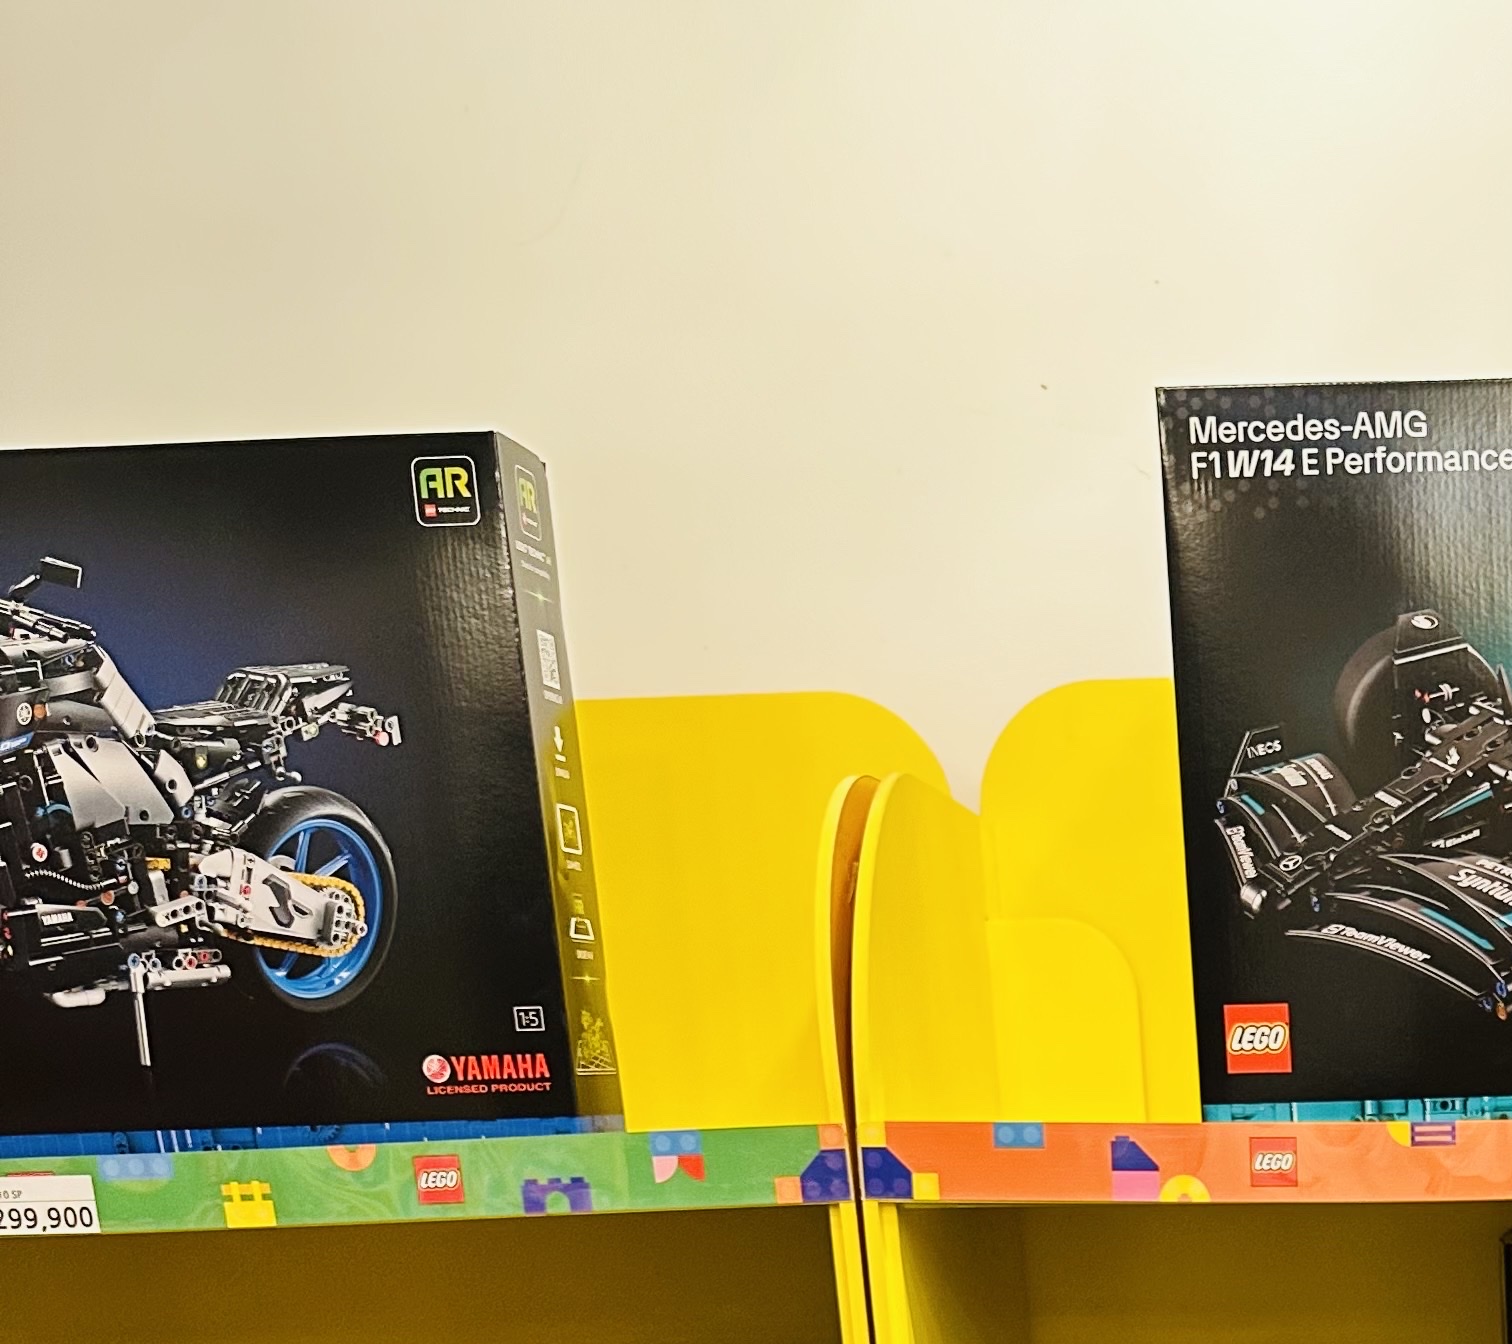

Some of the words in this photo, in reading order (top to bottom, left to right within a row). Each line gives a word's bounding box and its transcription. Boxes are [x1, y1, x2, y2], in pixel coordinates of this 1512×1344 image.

[1188, 410, 1428, 444] Mercedes-AMG
[1191, 450, 1222, 480] F1
[1228, 448, 1295, 479] W14
[1301, 447, 1320, 477] E
[419, 466, 472, 500] AR
[1339, 926, 1432, 962] TeamViewer
[518, 1011, 539, 1027] 1:5
[1229, 1022, 1288, 1055] LEGO
[450, 1053, 551, 1082] YAMAHA
[426, 1084, 489, 1096] LICENSED
[490, 1081, 552, 1094] PRODUCT
[1253, 1150, 1295, 1174] LEGO
[419, 1170, 459, 1190] LEGO
